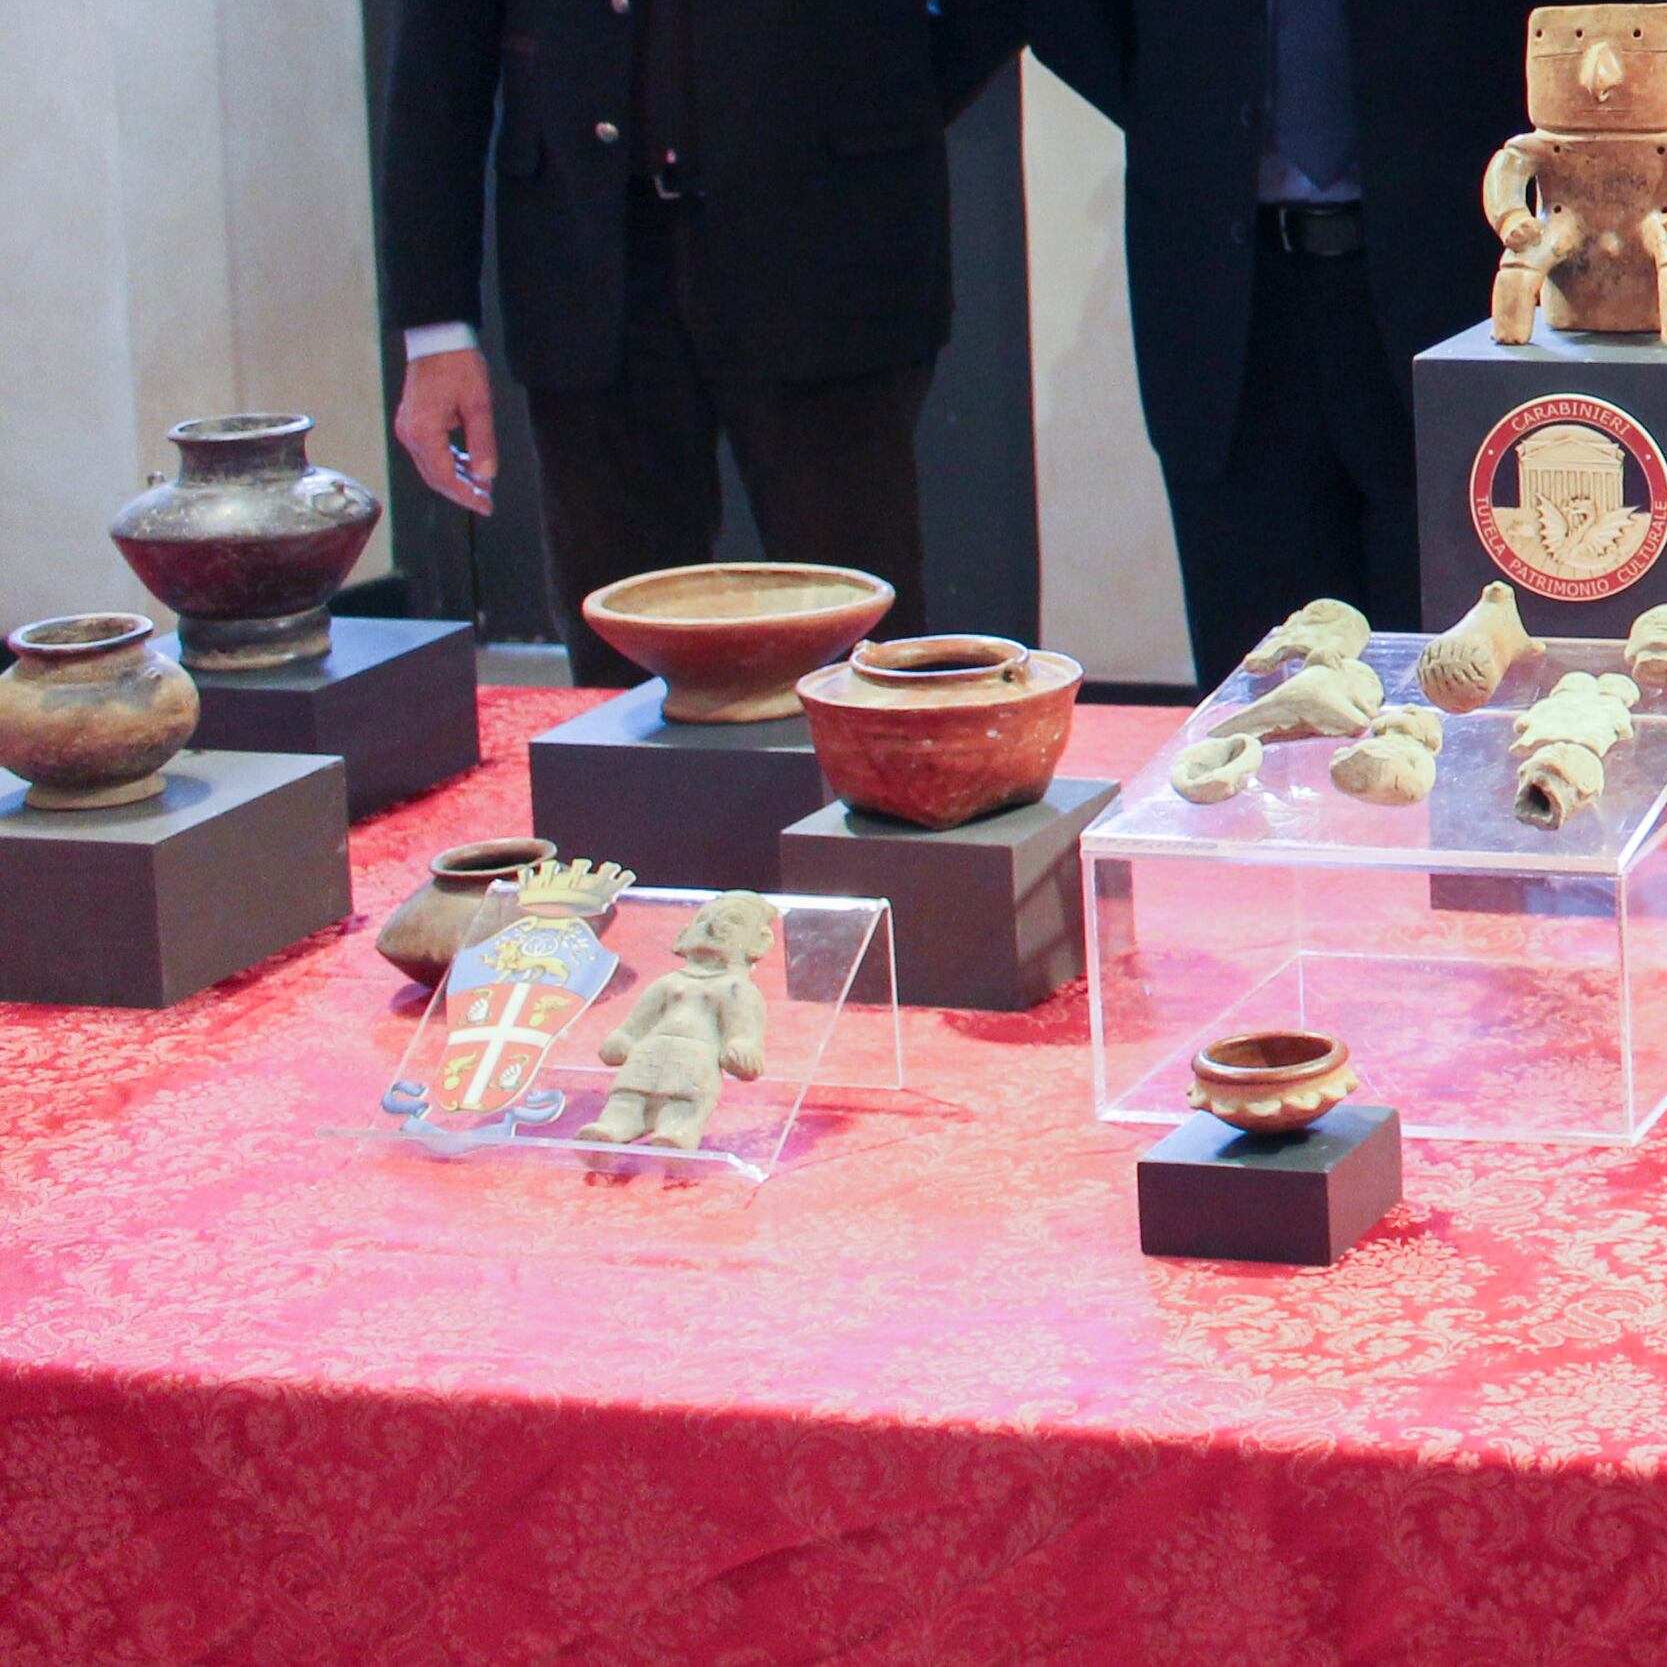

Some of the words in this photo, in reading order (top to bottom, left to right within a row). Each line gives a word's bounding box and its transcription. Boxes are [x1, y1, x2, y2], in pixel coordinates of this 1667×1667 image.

[1512, 402, 1630, 435] CARABINIERI
[1476, 495, 1506, 555] TUTELA
[1509, 560, 1609, 596] PATRIMONIO
[1617, 501, 1667, 583] CULTURALE
